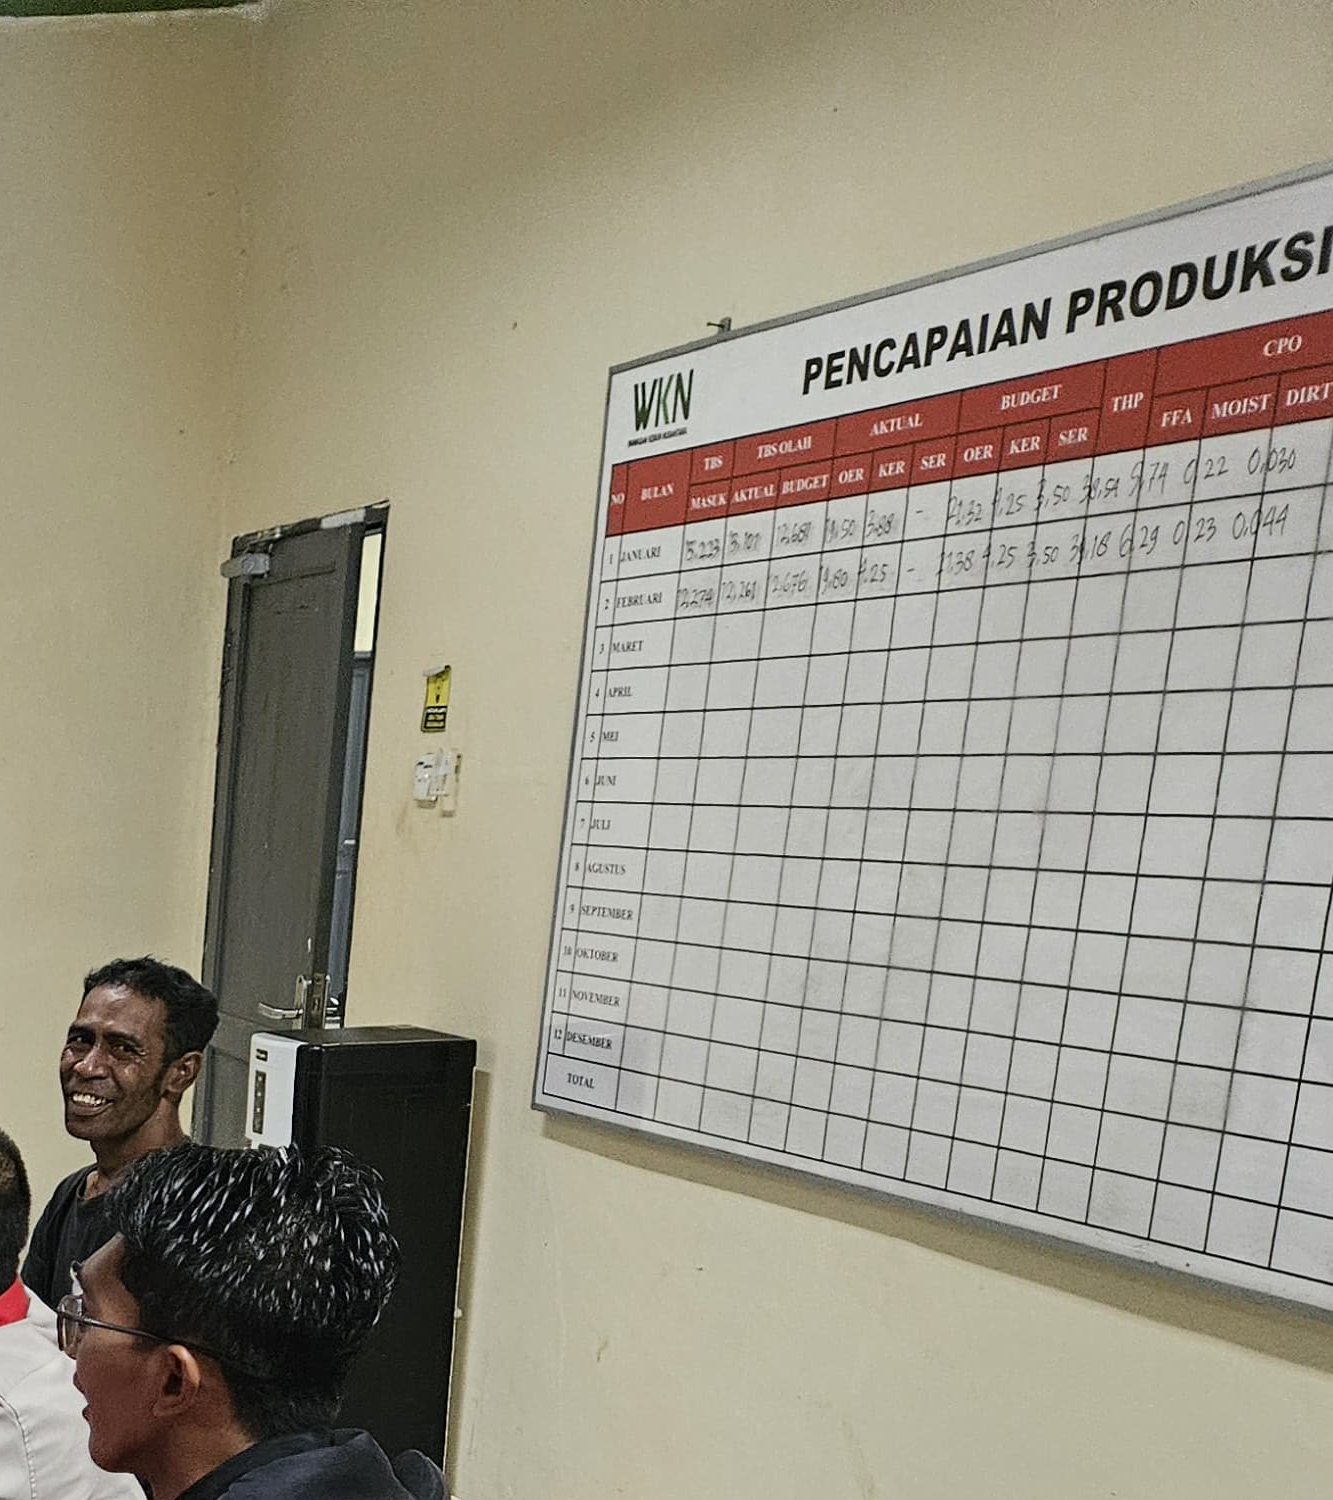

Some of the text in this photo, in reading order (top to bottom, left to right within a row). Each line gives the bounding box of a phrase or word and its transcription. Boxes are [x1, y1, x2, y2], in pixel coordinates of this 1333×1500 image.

[802, 225, 1333, 395] PENCAPAIAN PRODUKSI
[1262, 334, 1303, 357] CPO
[633, 368, 694, 432] WKN
[779, 435, 813, 454] OLAH
[869, 413, 924, 437] AKTUAL
[1000, 384, 1063, 411] BUDGET
[1111, 391, 1145, 413] THP
[640, 482, 675, 502] BULAN
[731, 484, 777, 504] AKTUAL
[781, 475, 831, 494] BUDGET
[838, 468, 865, 484] OER
[878, 460, 906, 478] KER
[920, 453, 947, 470] SER
[963, 444, 994, 463] OER
[1009, 435, 1042, 455] KER
[1057, 426, 1089, 446] SER
[1160, 408, 1193, 427] FFA
[1210, 393, 1272, 420] MOIST
[620, 545, 662, 563] JANUARI
[615, 591, 663, 610] FEBRUARI
[612, 639, 644, 653] MARET
[608, 685, 633, 698] APRIL
[602, 730, 620, 742] MEI
[595, 774, 618, 786] JUNI
[590, 818, 612, 831] JULI
[586, 862, 627, 876] AGUSTUS
[580, 904, 634, 921] SEPTEMBER
[576, 947, 619, 963] OKTOBER
[572, 989, 621, 1007] NOVEMBER
[565, 1031, 614, 1050] DESEMBER
[566, 1072, 596, 1090] TOTAL
